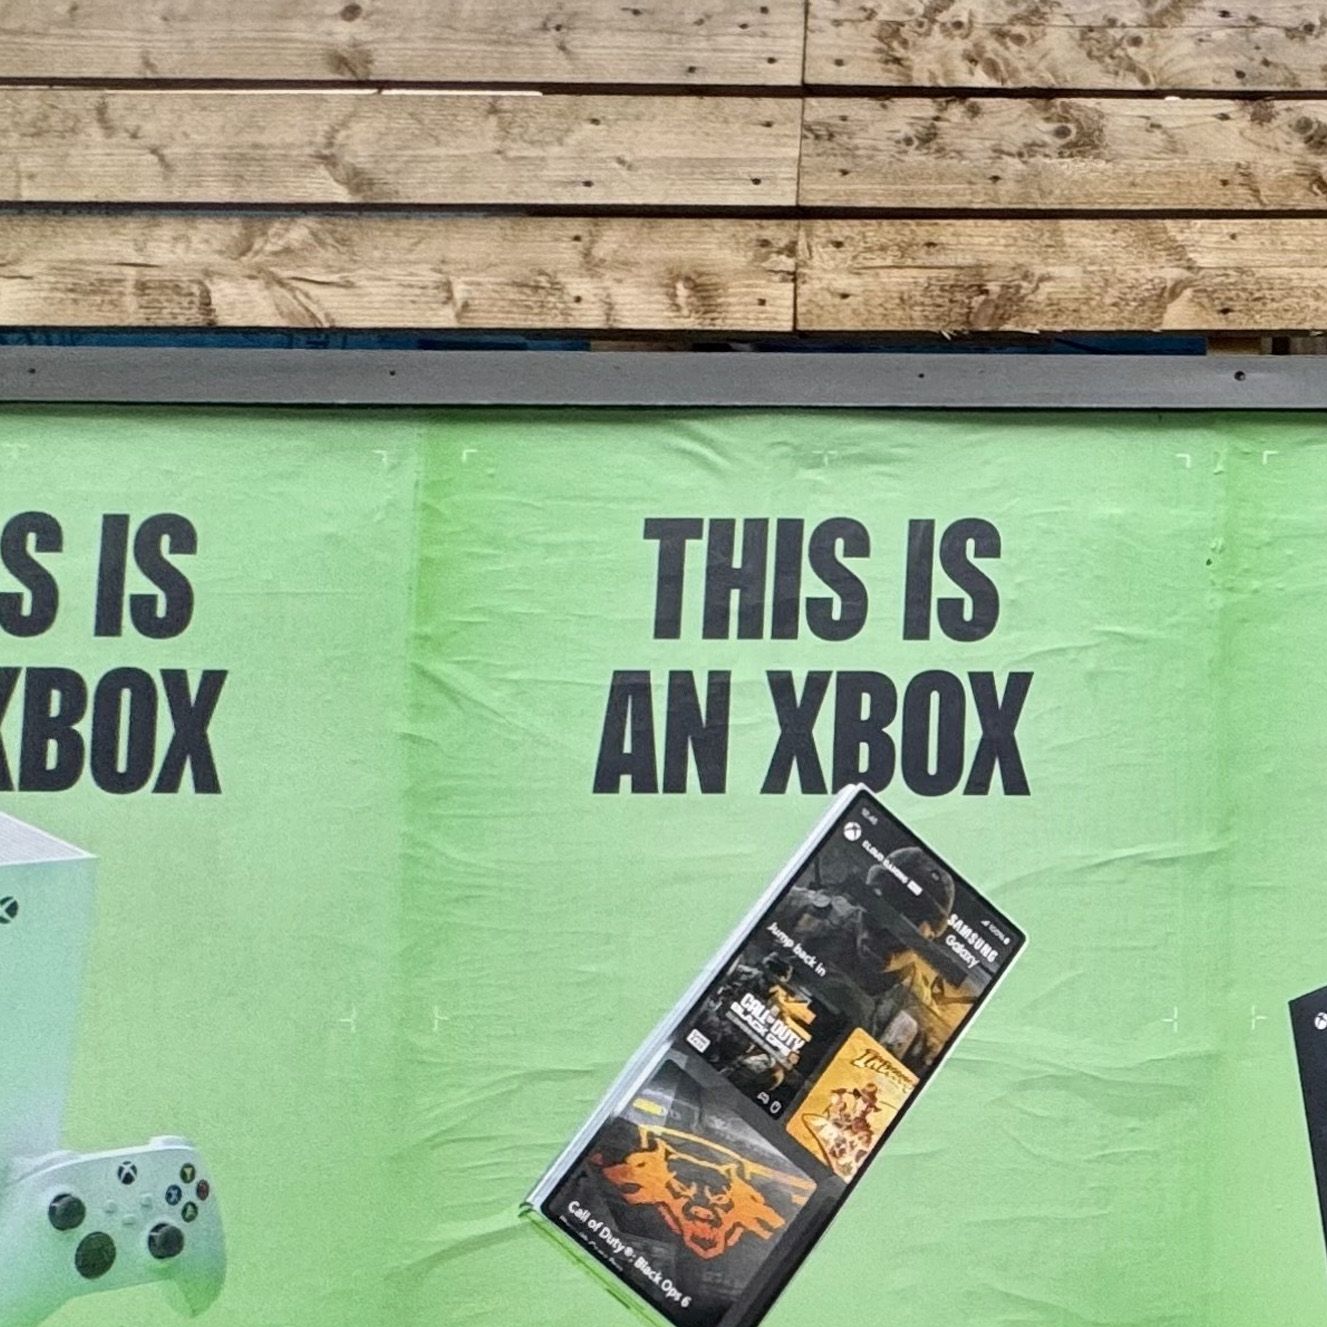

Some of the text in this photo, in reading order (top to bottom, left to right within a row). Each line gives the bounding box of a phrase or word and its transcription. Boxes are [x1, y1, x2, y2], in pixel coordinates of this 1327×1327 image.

[94, 513, 197, 639] IS
[643, 517, 1001, 642] THIS IS
[592, 669, 1034, 797] AN XBOX
[767, 921, 827, 978] Jump back in
[945, 934, 980, 968] Galaxy
[947, 913, 999, 964] SAMSUNG
[740, 992, 771, 1024] CALL
[769, 1022, 807, 1052] DUTY
[568, 1201, 590, 1225] Call
[587, 1218, 603, 1234] of
[634, 1256, 662, 1285] Black
[660, 1277, 684, 1303] Ops
[680, 1295, 692, 1307] 6
